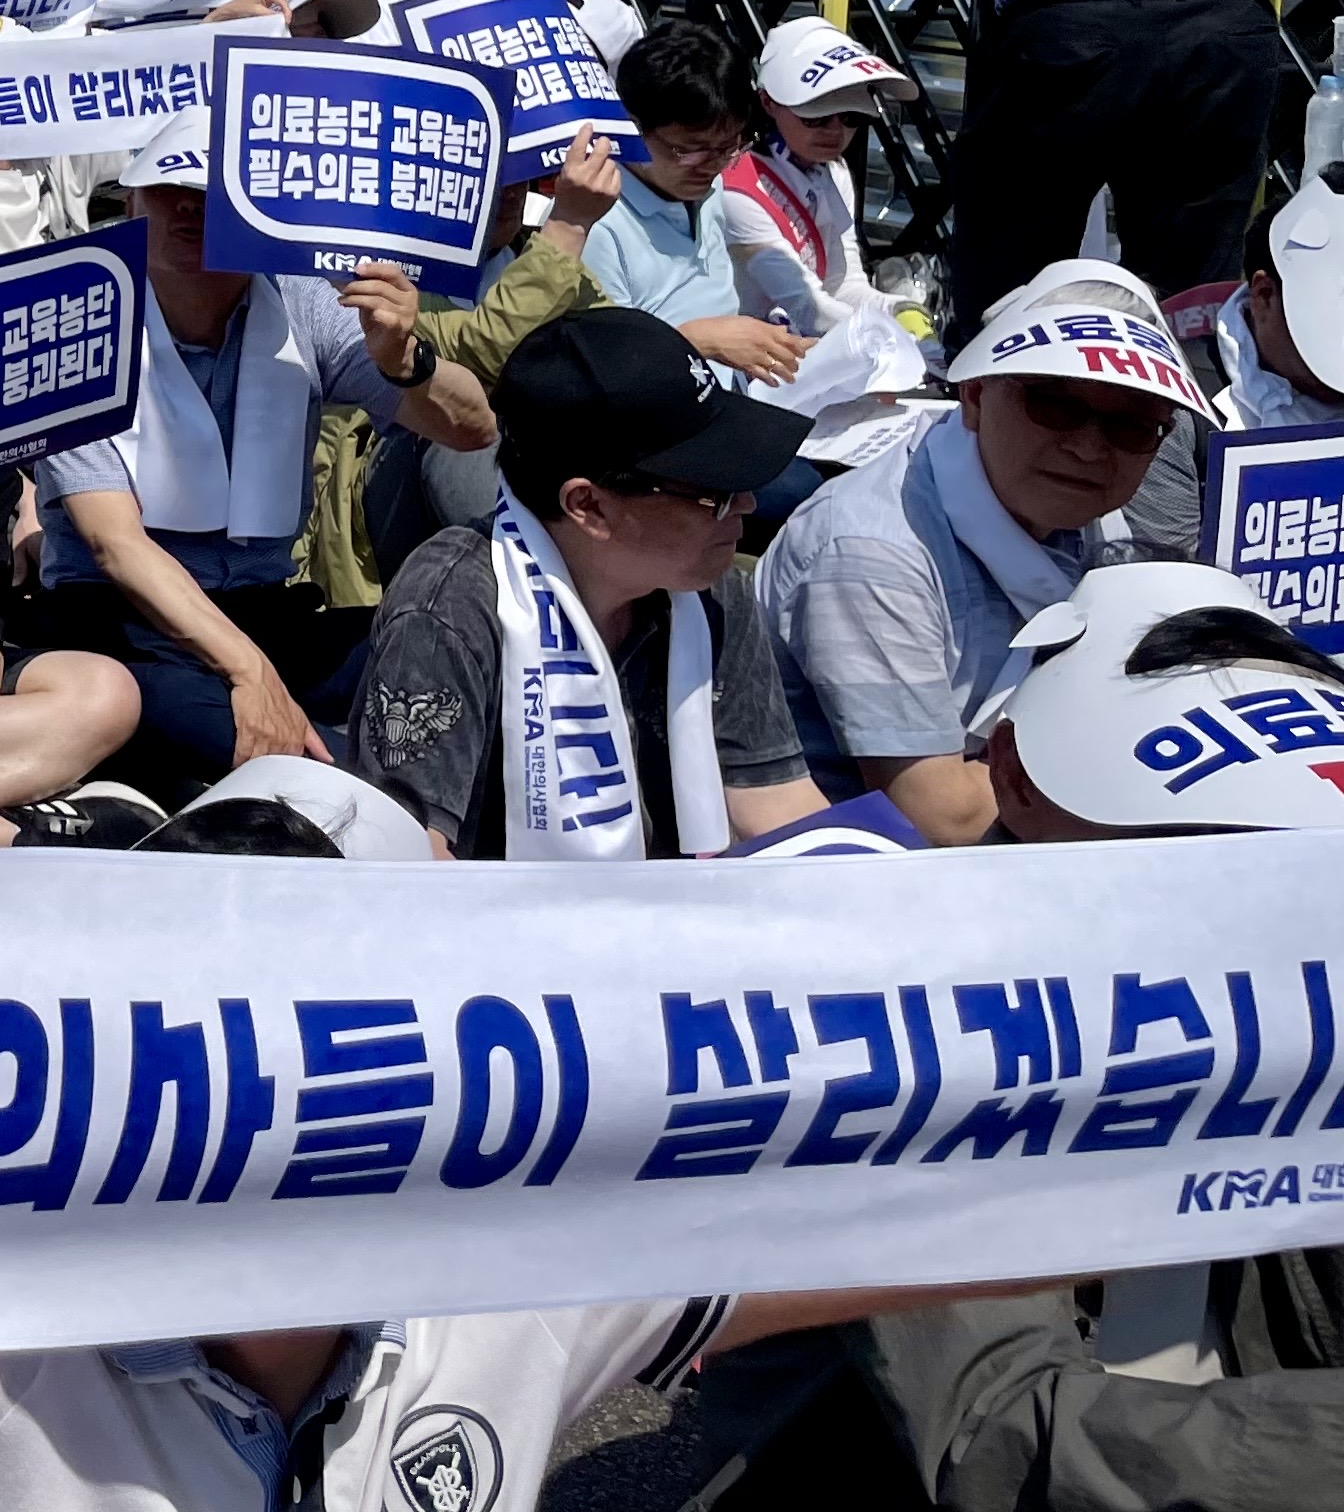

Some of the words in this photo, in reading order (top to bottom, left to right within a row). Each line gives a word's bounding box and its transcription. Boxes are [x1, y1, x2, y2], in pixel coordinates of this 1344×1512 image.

[68, 62, 212, 120] 살리겠습
[513, 61, 573, 112] 의료
[250, 93, 381, 151] 의료농단
[390, 107, 489, 170] 교육농단
[248, 146, 380, 206] 필수의료
[390, 172, 482, 225] 붕괴된다
[2, 282, 114, 347] 교육농단
[2, 337, 115, 403] 붕괴된다
[1240, 494, 1344, 563] 의료농
[523, 668, 545, 743] KMA
[1133, 688, 1344, 795] 의료
[635, 960, 1344, 1182] 살리겠습니
[1177, 1165, 1301, 1215] KMA
